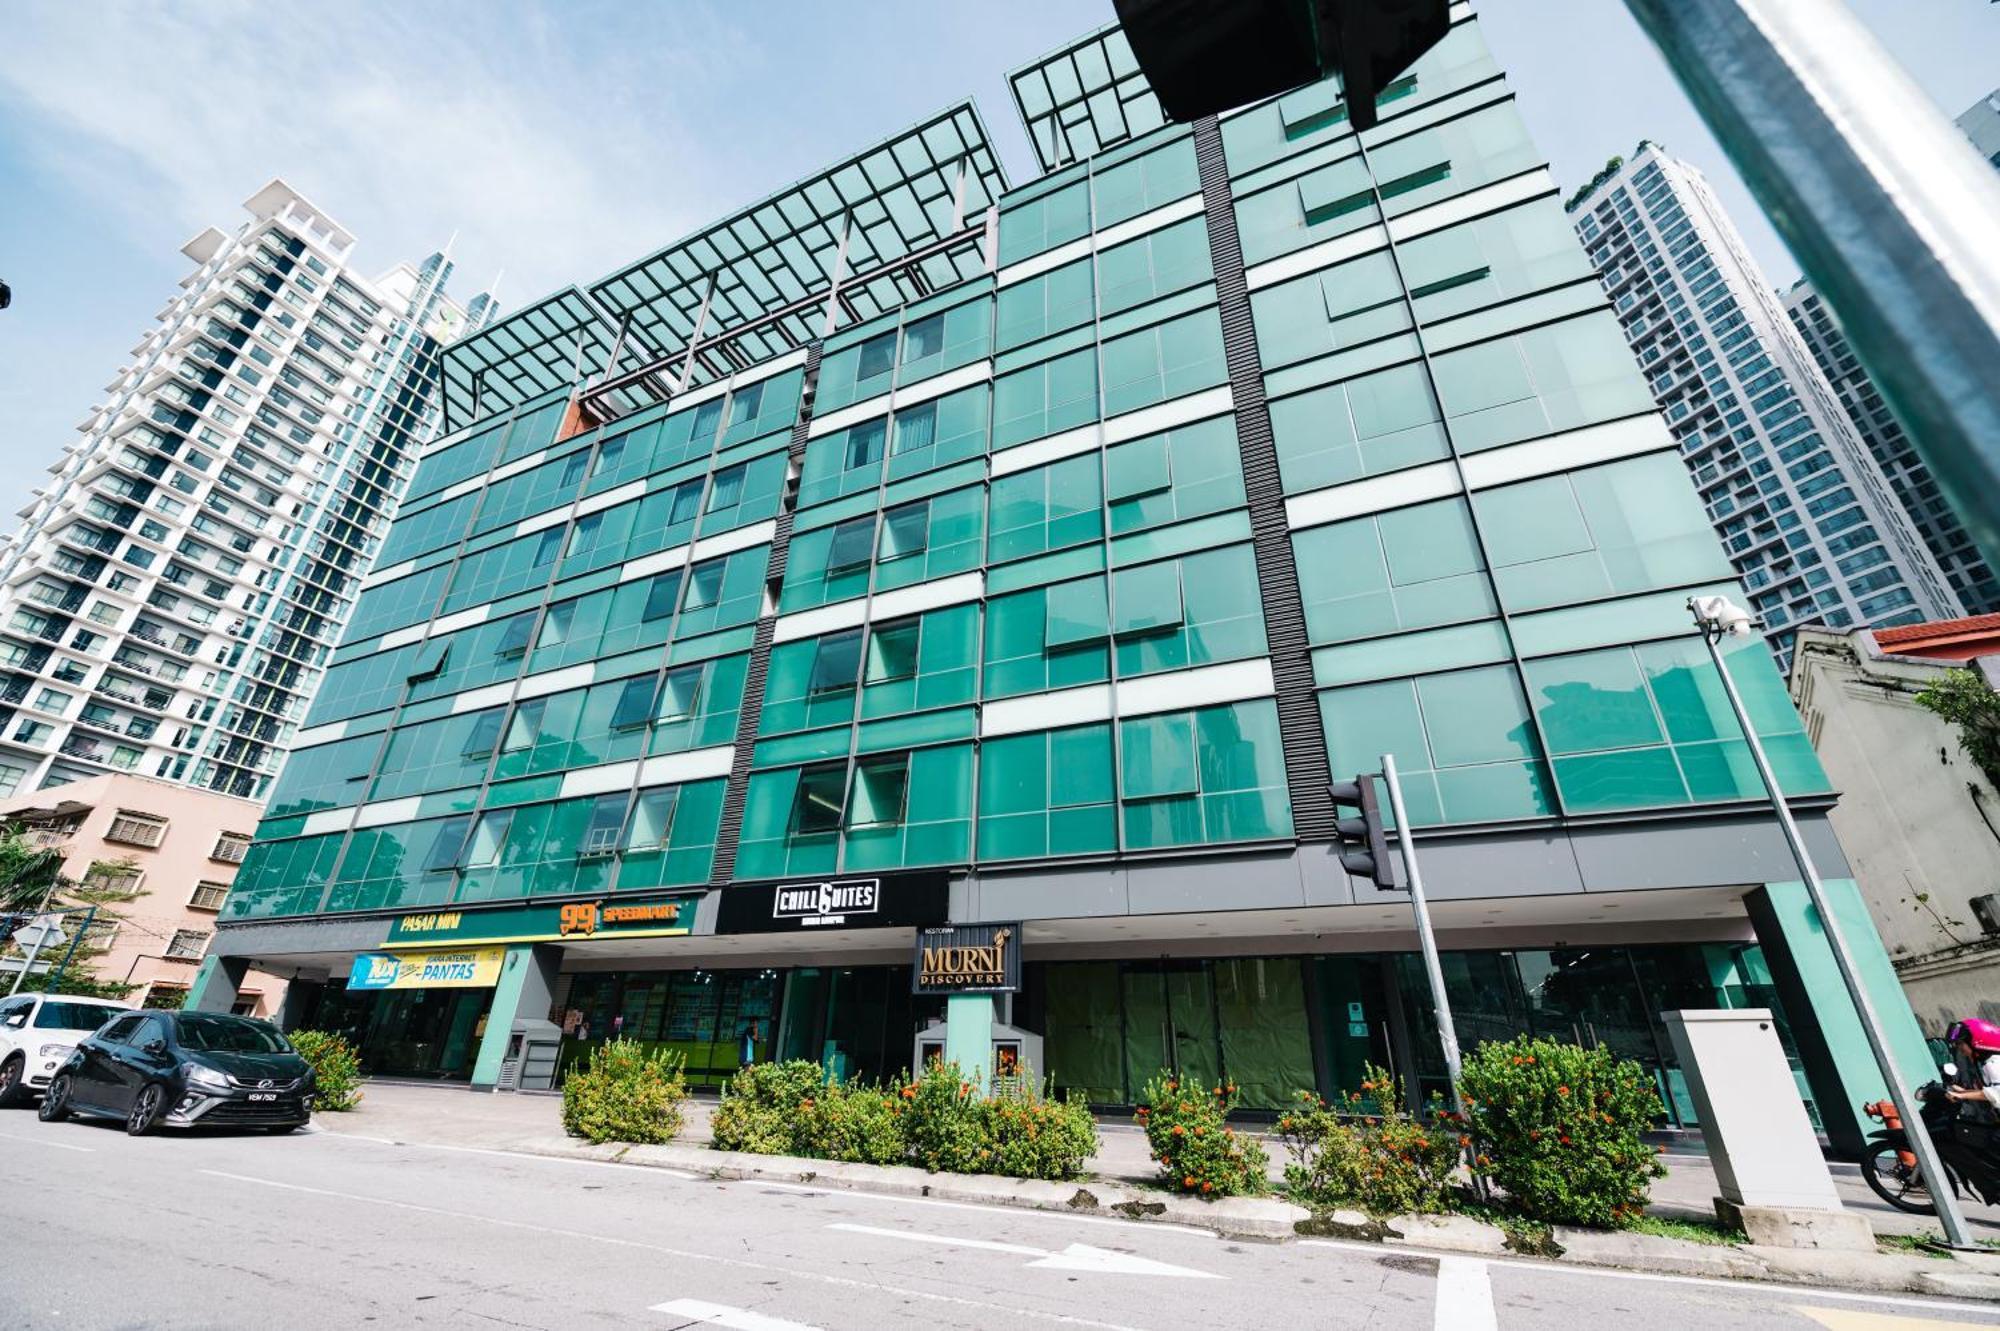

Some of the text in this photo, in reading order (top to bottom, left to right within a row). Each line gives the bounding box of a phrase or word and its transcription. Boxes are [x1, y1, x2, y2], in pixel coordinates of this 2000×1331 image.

[779, 889, 818, 911] CHILL
[400, 914, 436, 932] PASAR
[560, 903, 597, 935] 99
[921, 945, 1005, 973] MURNI
[421, 963, 476, 980] PANTAS
[920, 974, 1005, 985] DISCOVERY
